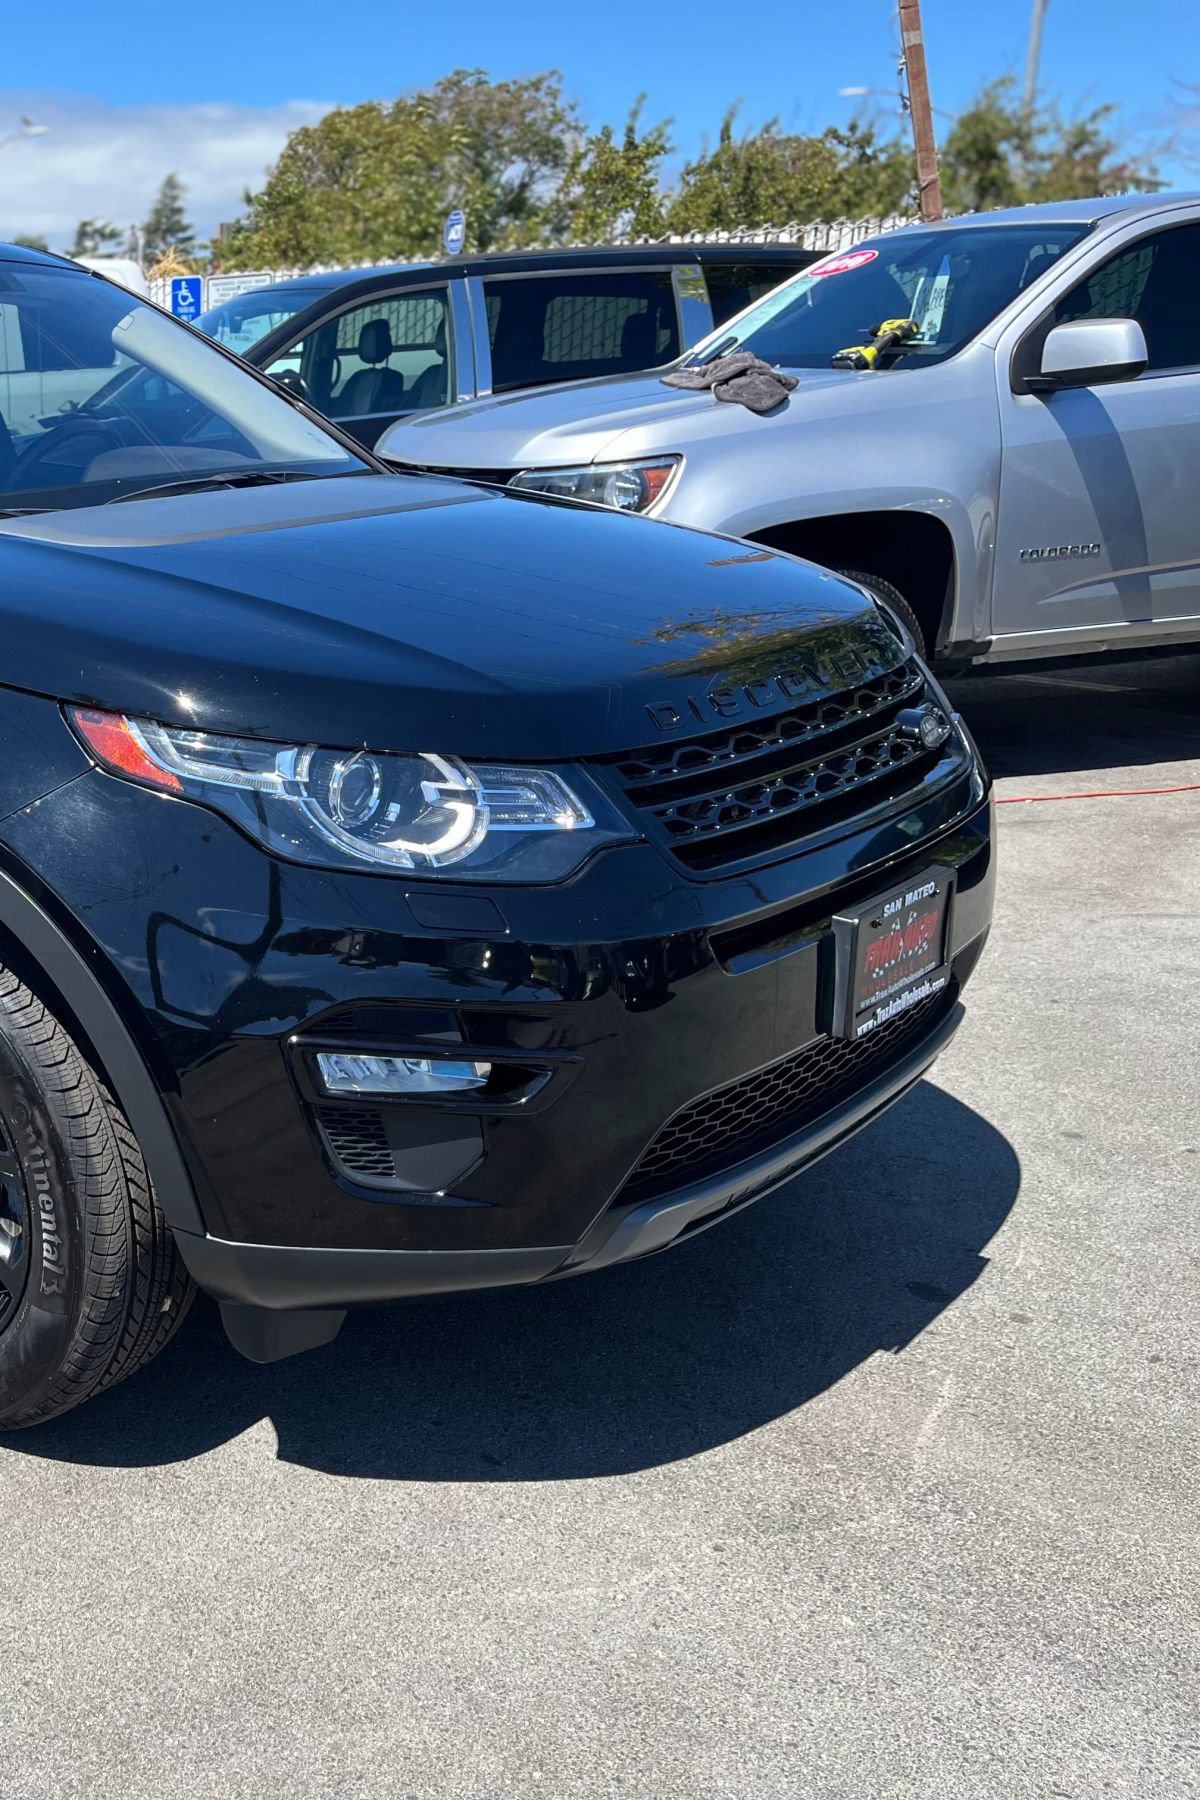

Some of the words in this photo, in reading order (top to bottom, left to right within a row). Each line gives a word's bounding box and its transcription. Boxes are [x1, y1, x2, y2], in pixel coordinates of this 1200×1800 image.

[1019, 543, 1101, 560] COLORADO
[883, 897, 903, 917] SAN
[904, 881, 935, 907] MATEO
[11, 1097, 66, 1277] Continental
